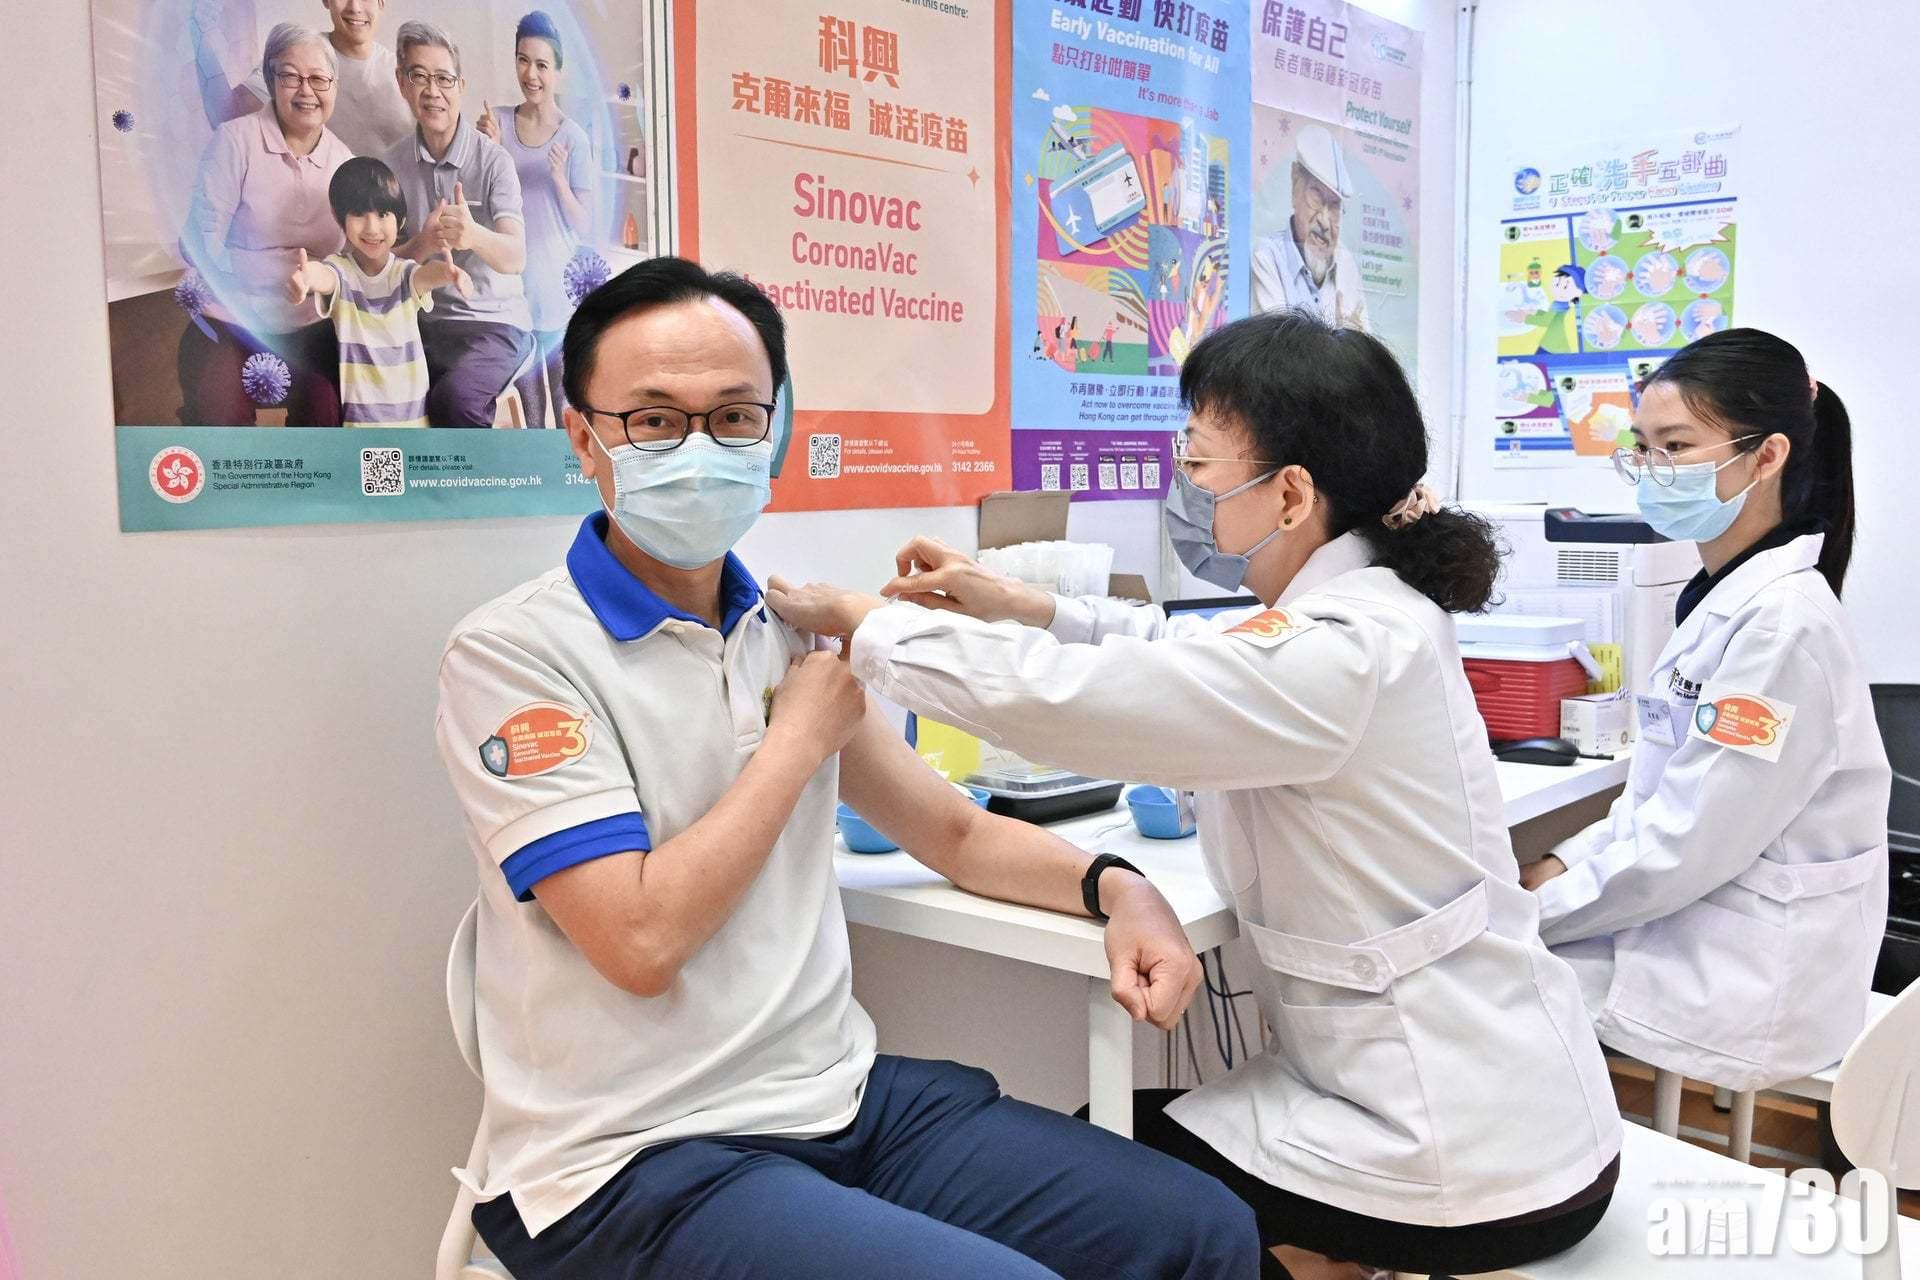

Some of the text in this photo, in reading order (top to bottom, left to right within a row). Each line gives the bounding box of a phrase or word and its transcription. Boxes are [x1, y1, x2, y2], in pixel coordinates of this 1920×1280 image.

[939, 2, 969, 19] centre:
[1050, 8, 1221, 75] Early Vaccination for All
[1261, 0, 1349, 59] 保護自己
[818, 14, 901, 90] 科興
[1051, 42, 1152, 83] 點只打針咁簡單
[1137, 86, 1155, 102] It's
[730, 71, 969, 155] 克爾來福 滅活疫苗
[1345, 100, 1413, 135] Protect Yourself
[793, 172, 922, 232] Sinovac
[791, 231, 918, 276] CoronaVac
[743, 273, 964, 324] activated Vaccine
[1078, 411, 1096, 422] Hong
[1097, 411, 1115, 422] Kong
[1081, 399, 1093, 409] Act
[1108, 400, 1116, 409] to
[1117, 402, 1151, 410] overcome
[211, 458, 304, 470] 香港特別行政區政府
[227, 472, 271, 480] Government
[293, 472, 313, 481] Hong
[313, 471, 332, 480] Kong
[843, 462, 943, 475] www.covidvaccine.gov.hk
[951, 461, 995, 473] 3142 2366
[212, 481, 315, 491] Special Administrative Region
[409, 475, 543, 489] www.covidvaccine.gov.hk
[557, 719, 585, 757] 3
